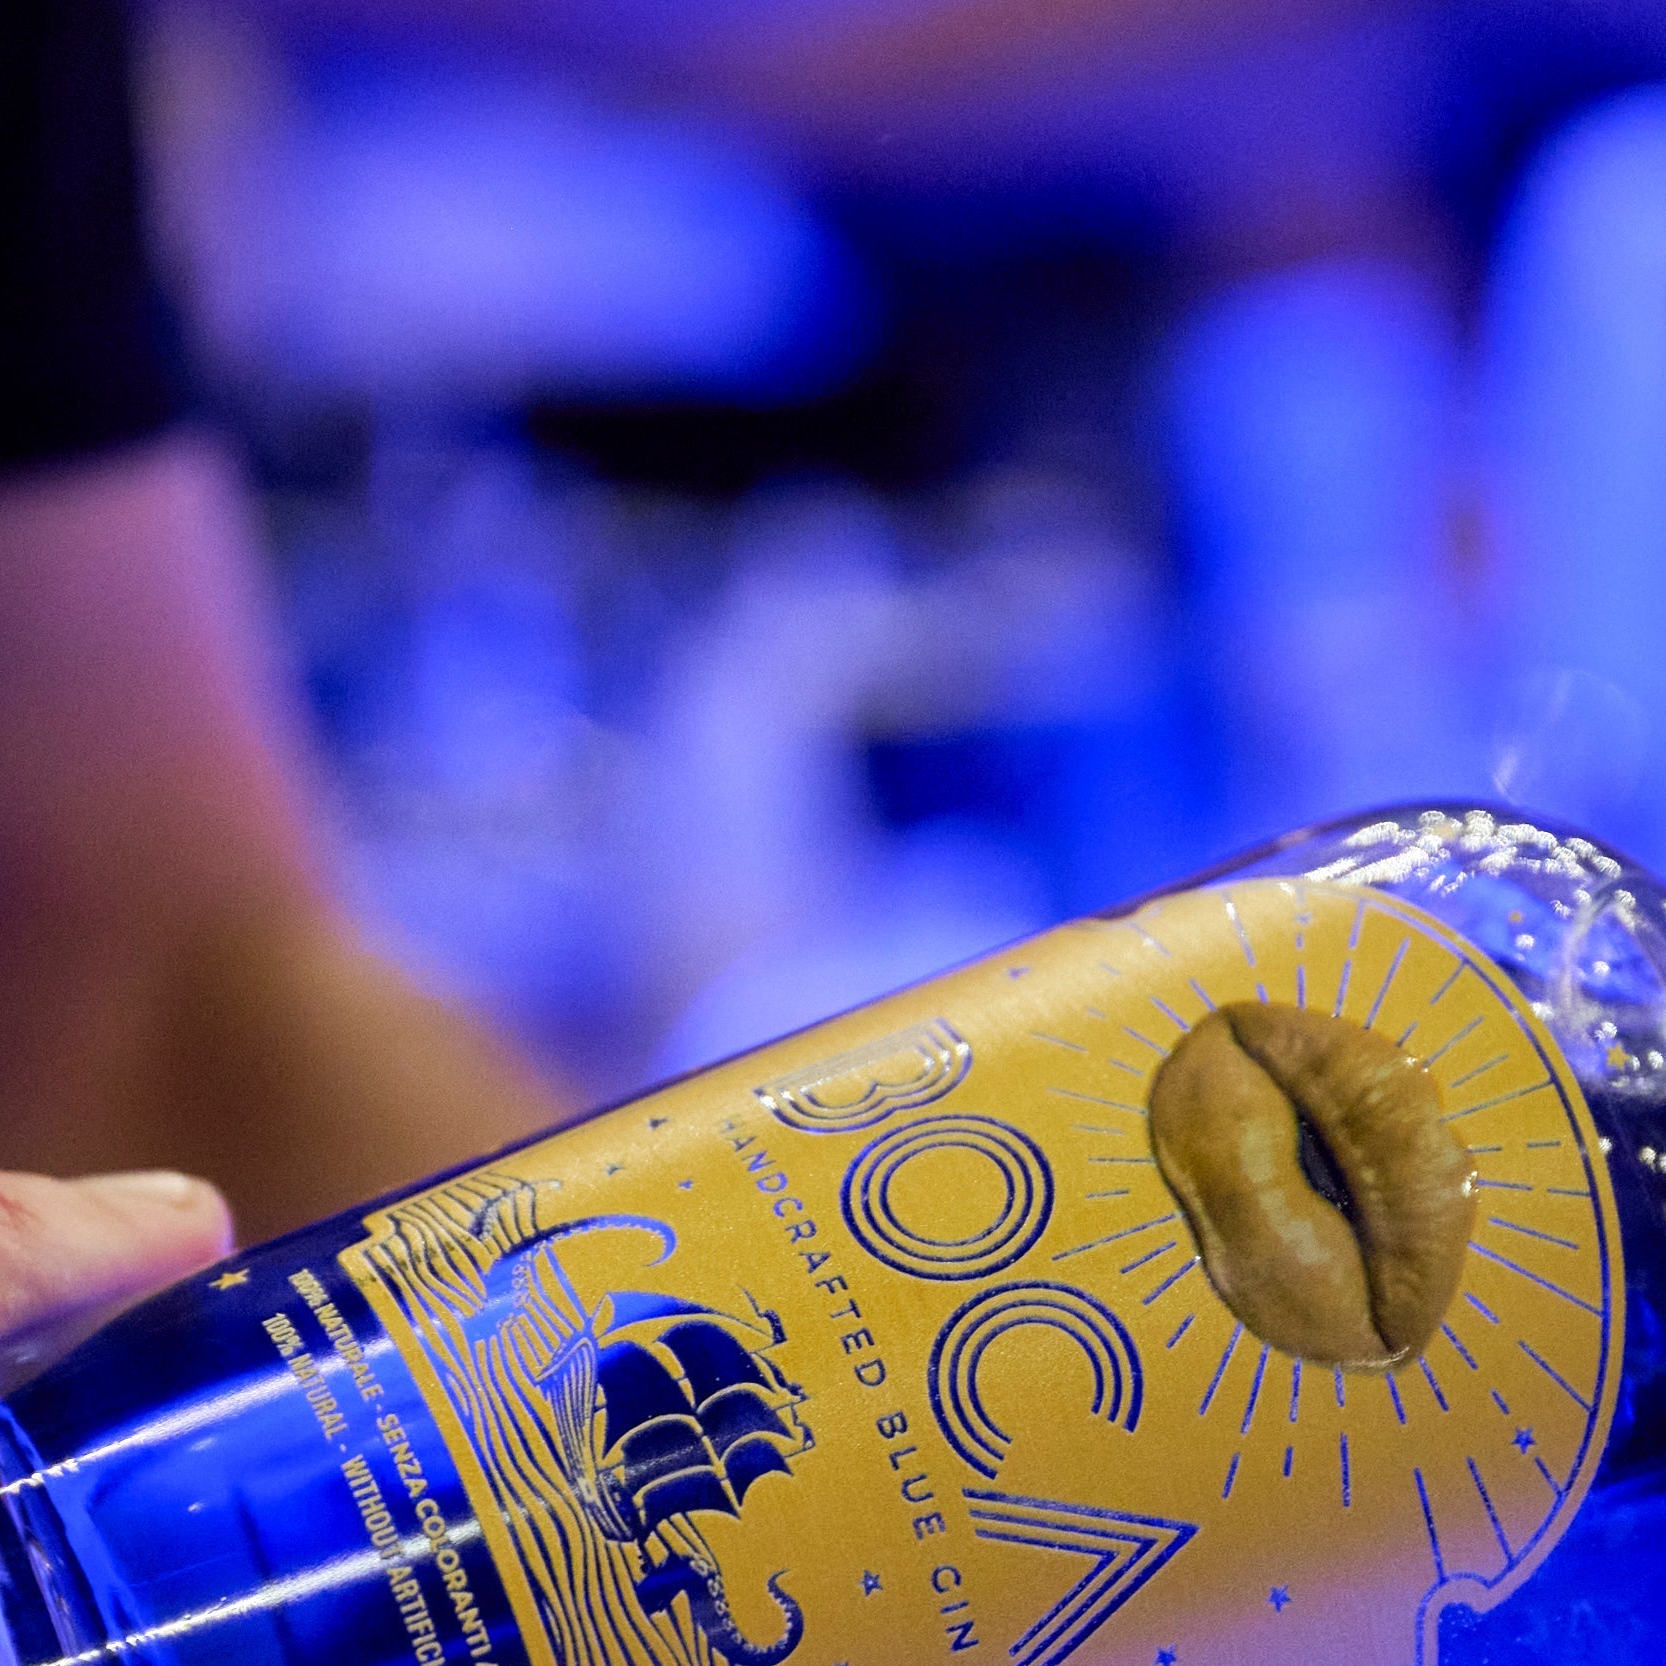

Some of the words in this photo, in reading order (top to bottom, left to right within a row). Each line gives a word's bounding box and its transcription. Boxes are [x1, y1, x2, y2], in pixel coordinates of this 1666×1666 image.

[261, 1311, 305, 1358] 100%
[287, 1352, 349, 1442] NATURAL
[341, 1453, 404, 1560] WITHOUT
[313, 1302, 385, 1402] NATURALE
[376, 1413, 429, 1499] SENZA
[415, 1498, 493, 1657] COLORANTI
[717, 1117, 887, 1390] HANDCRAFTED
[876, 1410, 947, 1541] BLUE
[929, 1564, 980, 1655] GIN
